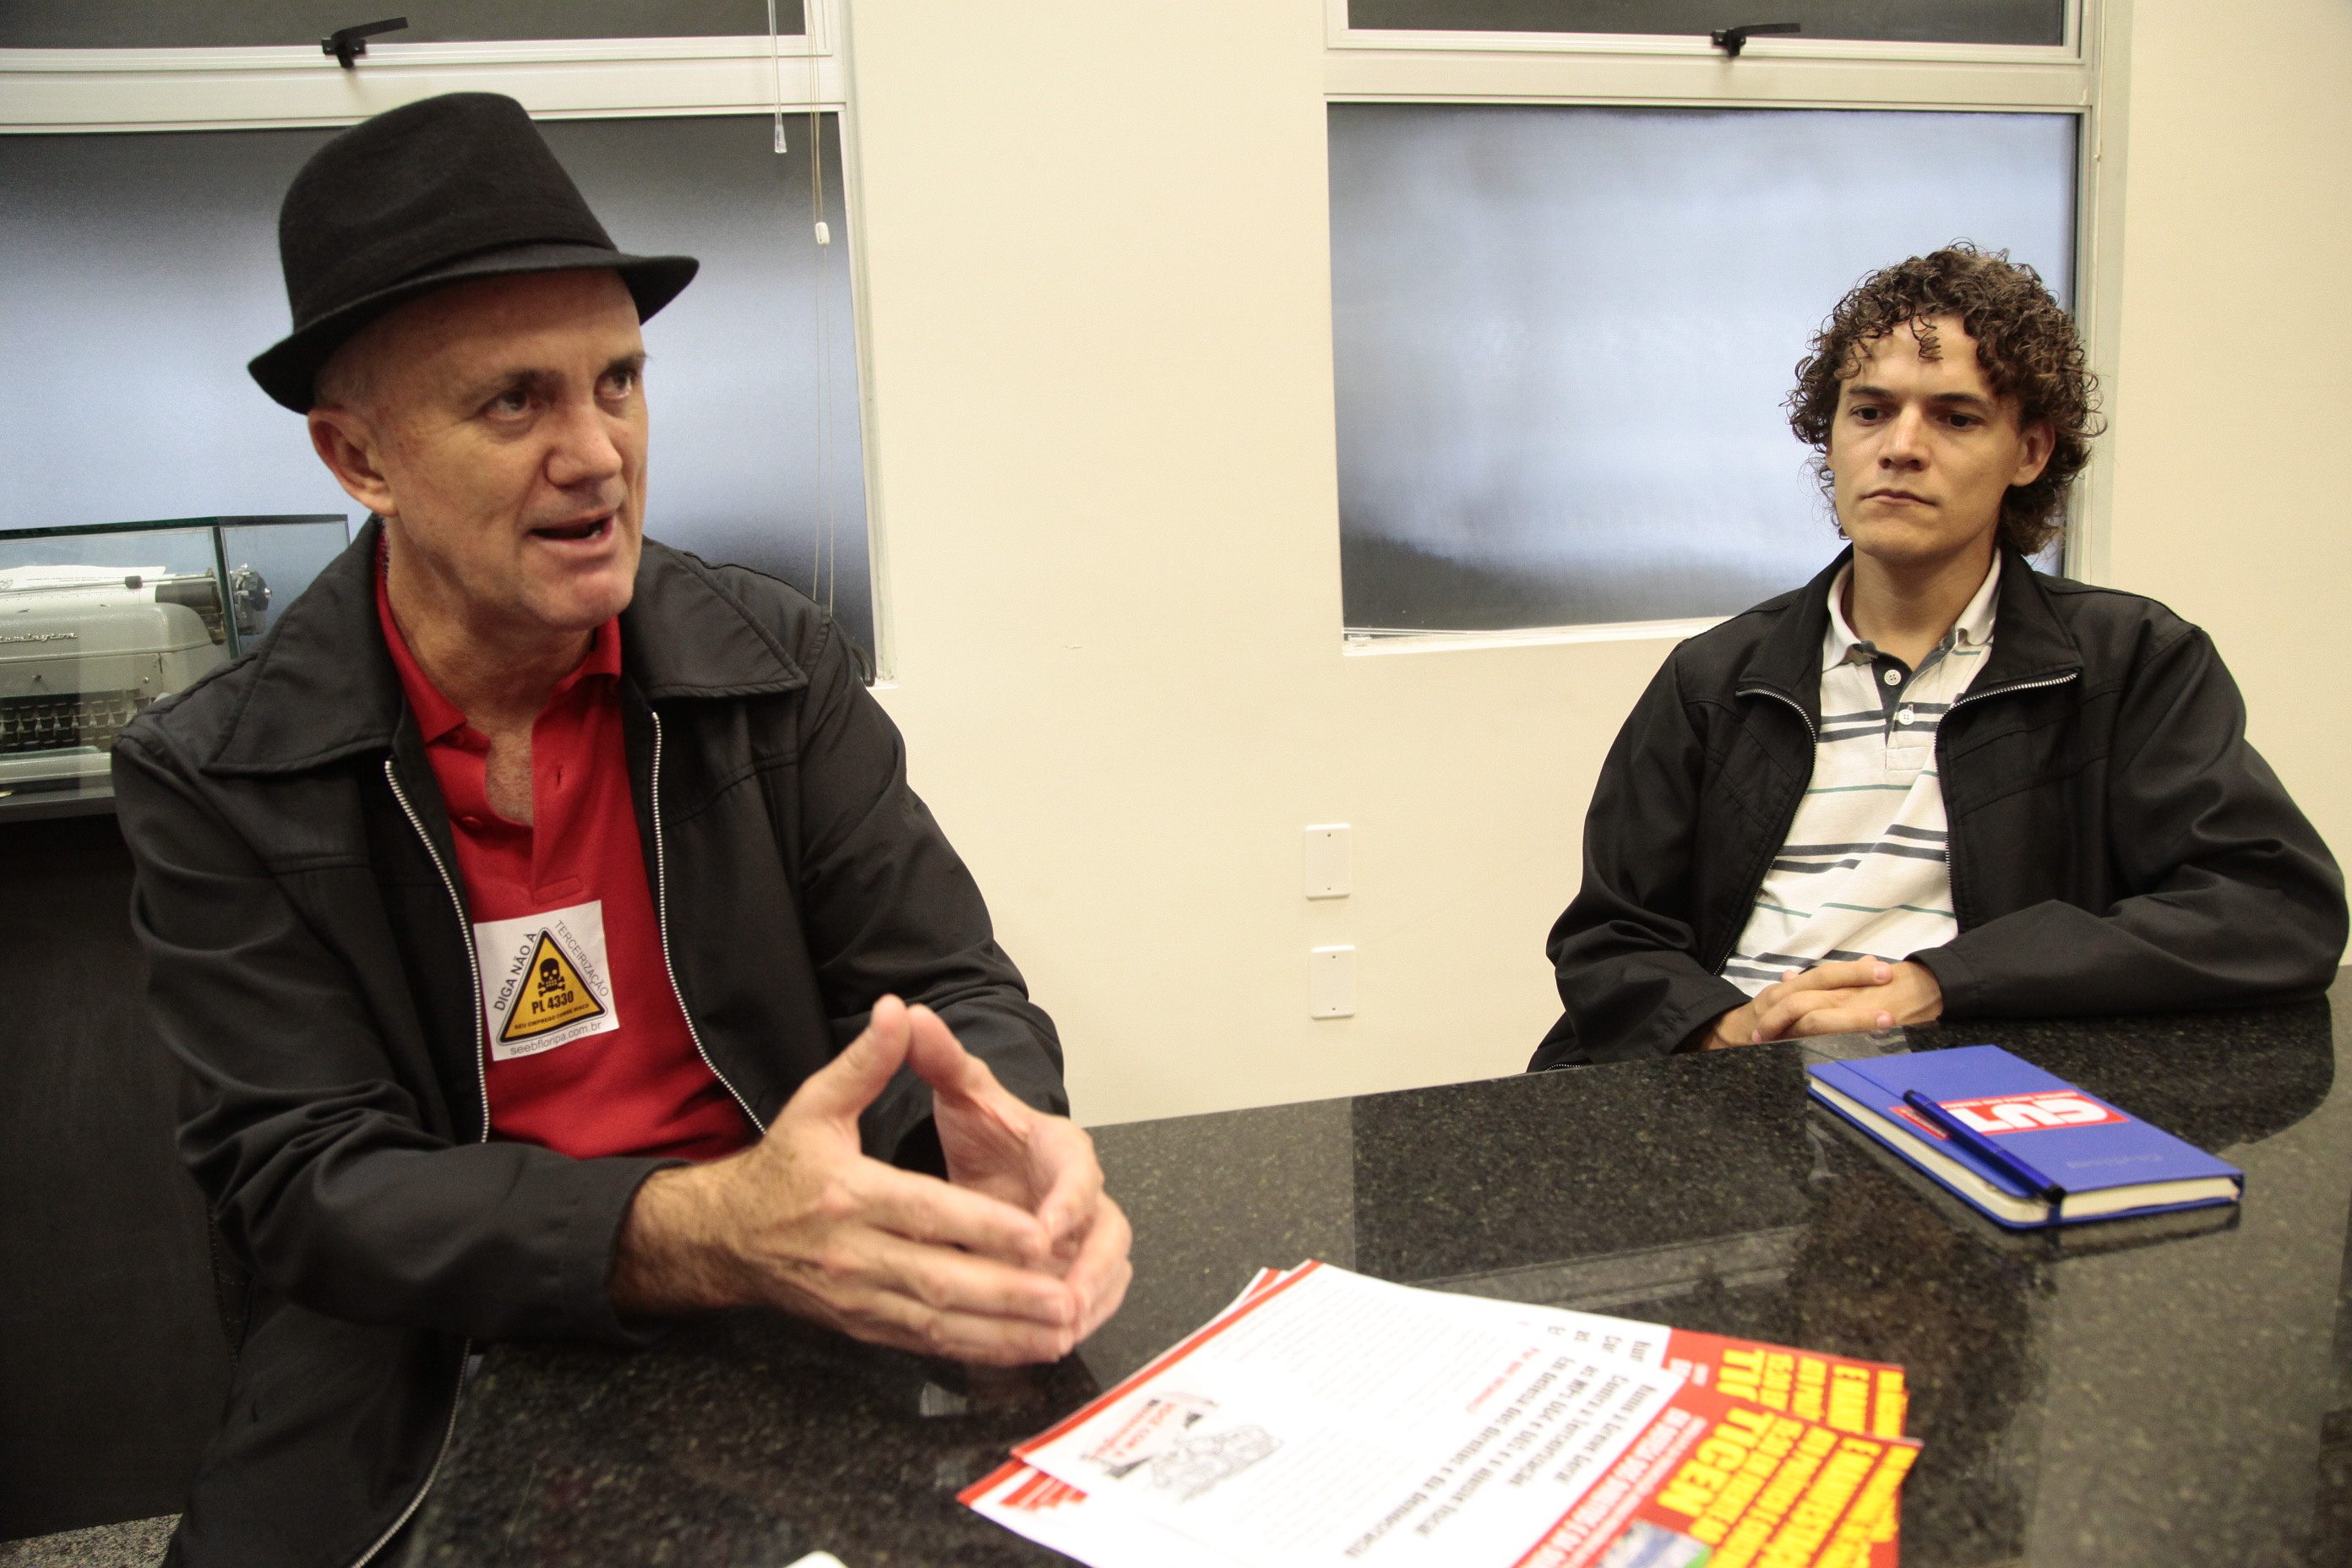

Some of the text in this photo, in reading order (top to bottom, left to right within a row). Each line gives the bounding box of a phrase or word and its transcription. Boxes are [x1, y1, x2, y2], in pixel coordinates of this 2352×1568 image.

[494, 978, 518, 1011] DIGA
[510, 945, 531, 976] NÃO
[554, 919, 609, 997] TERCEIRIZAÇÃO
[527, 1015, 556, 1027] EMPREGO
[531, 990, 574, 1015] PL 4330
[1947, 1097, 2108, 1133] CUT
[1656, 1407, 1777, 1517] TICEN
